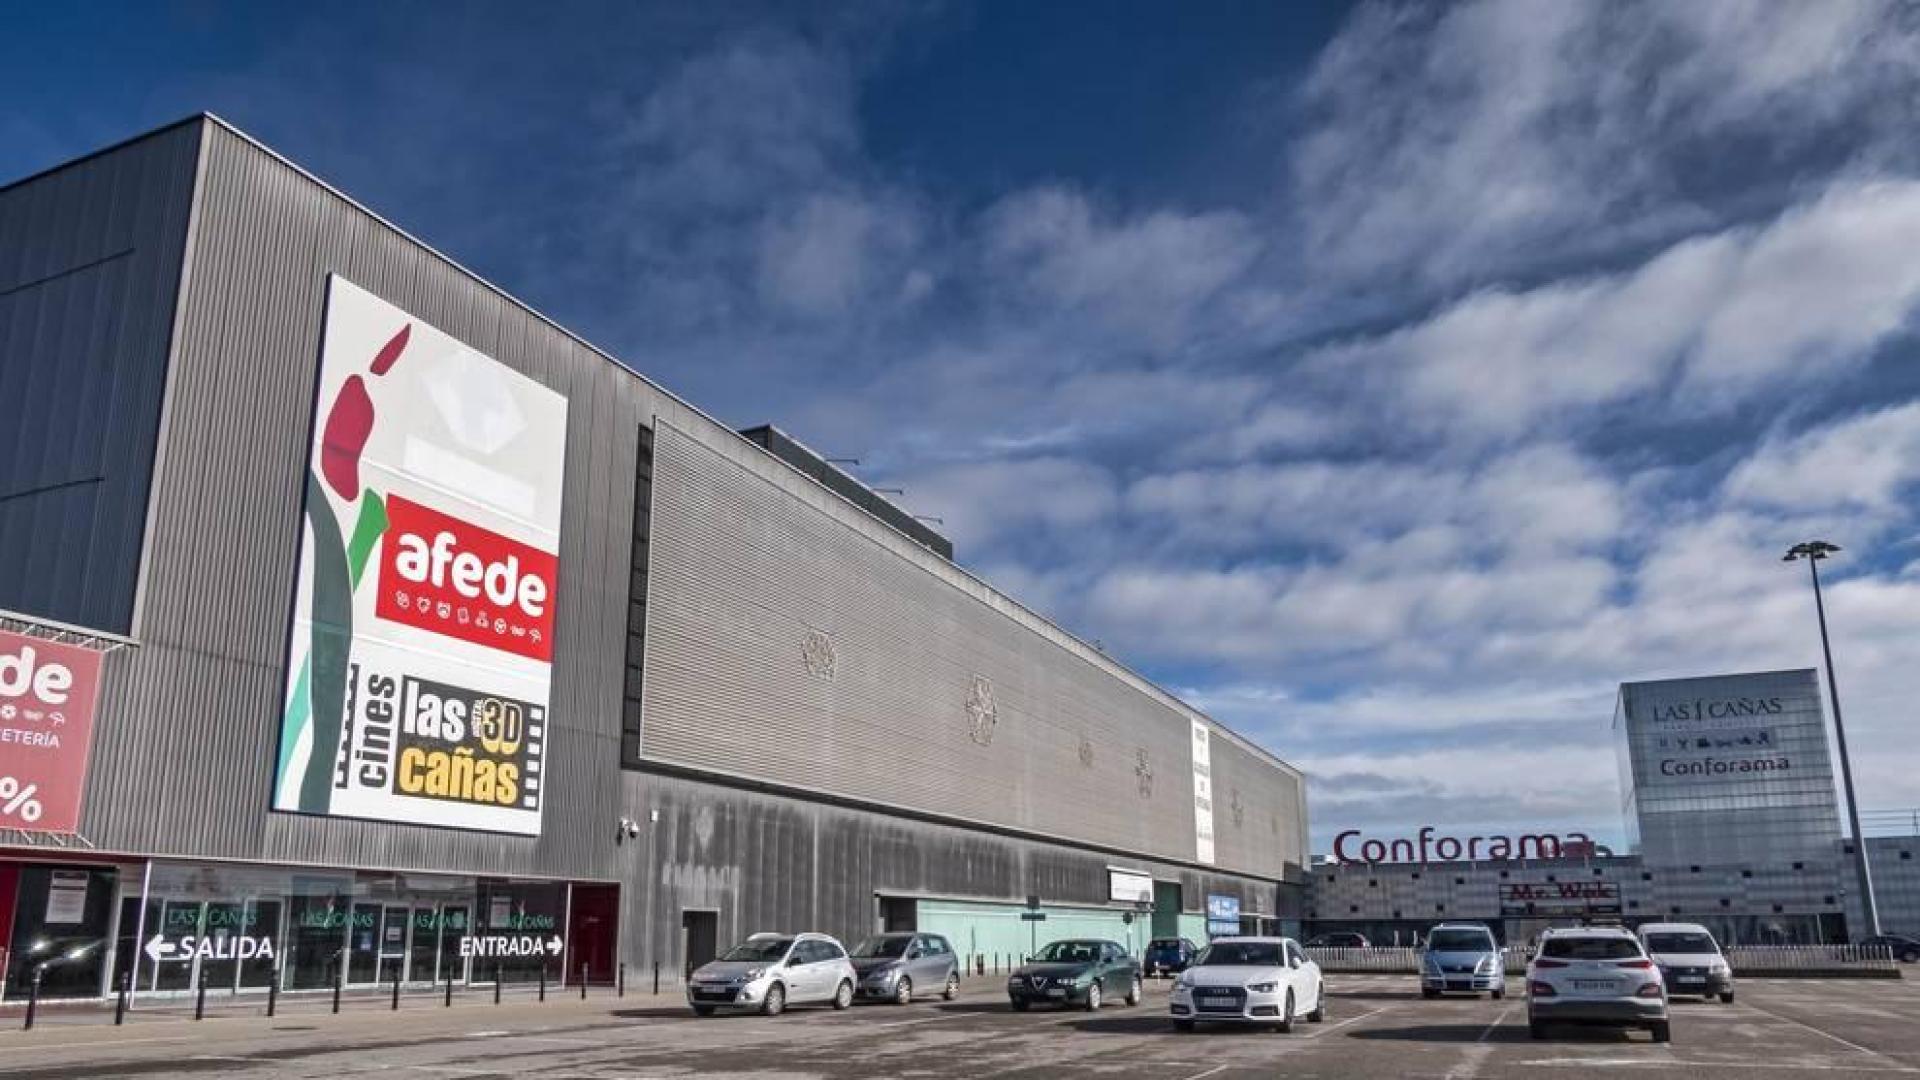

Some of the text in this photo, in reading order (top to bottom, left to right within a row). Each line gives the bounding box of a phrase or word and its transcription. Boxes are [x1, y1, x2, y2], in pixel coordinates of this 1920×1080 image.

[395, 531, 547, 617] afede
[403, 680, 466, 742] las
[481, 698, 522, 754] 3D
[1654, 697, 1782, 722] LAS CAÑAS
[355, 674, 395, 788] cines
[399, 746, 519, 804] cañas
[1661, 757, 1790, 776] Conforama
[179, 935, 274, 959] SALIDA
[459, 935, 545, 957] ENTRADA
